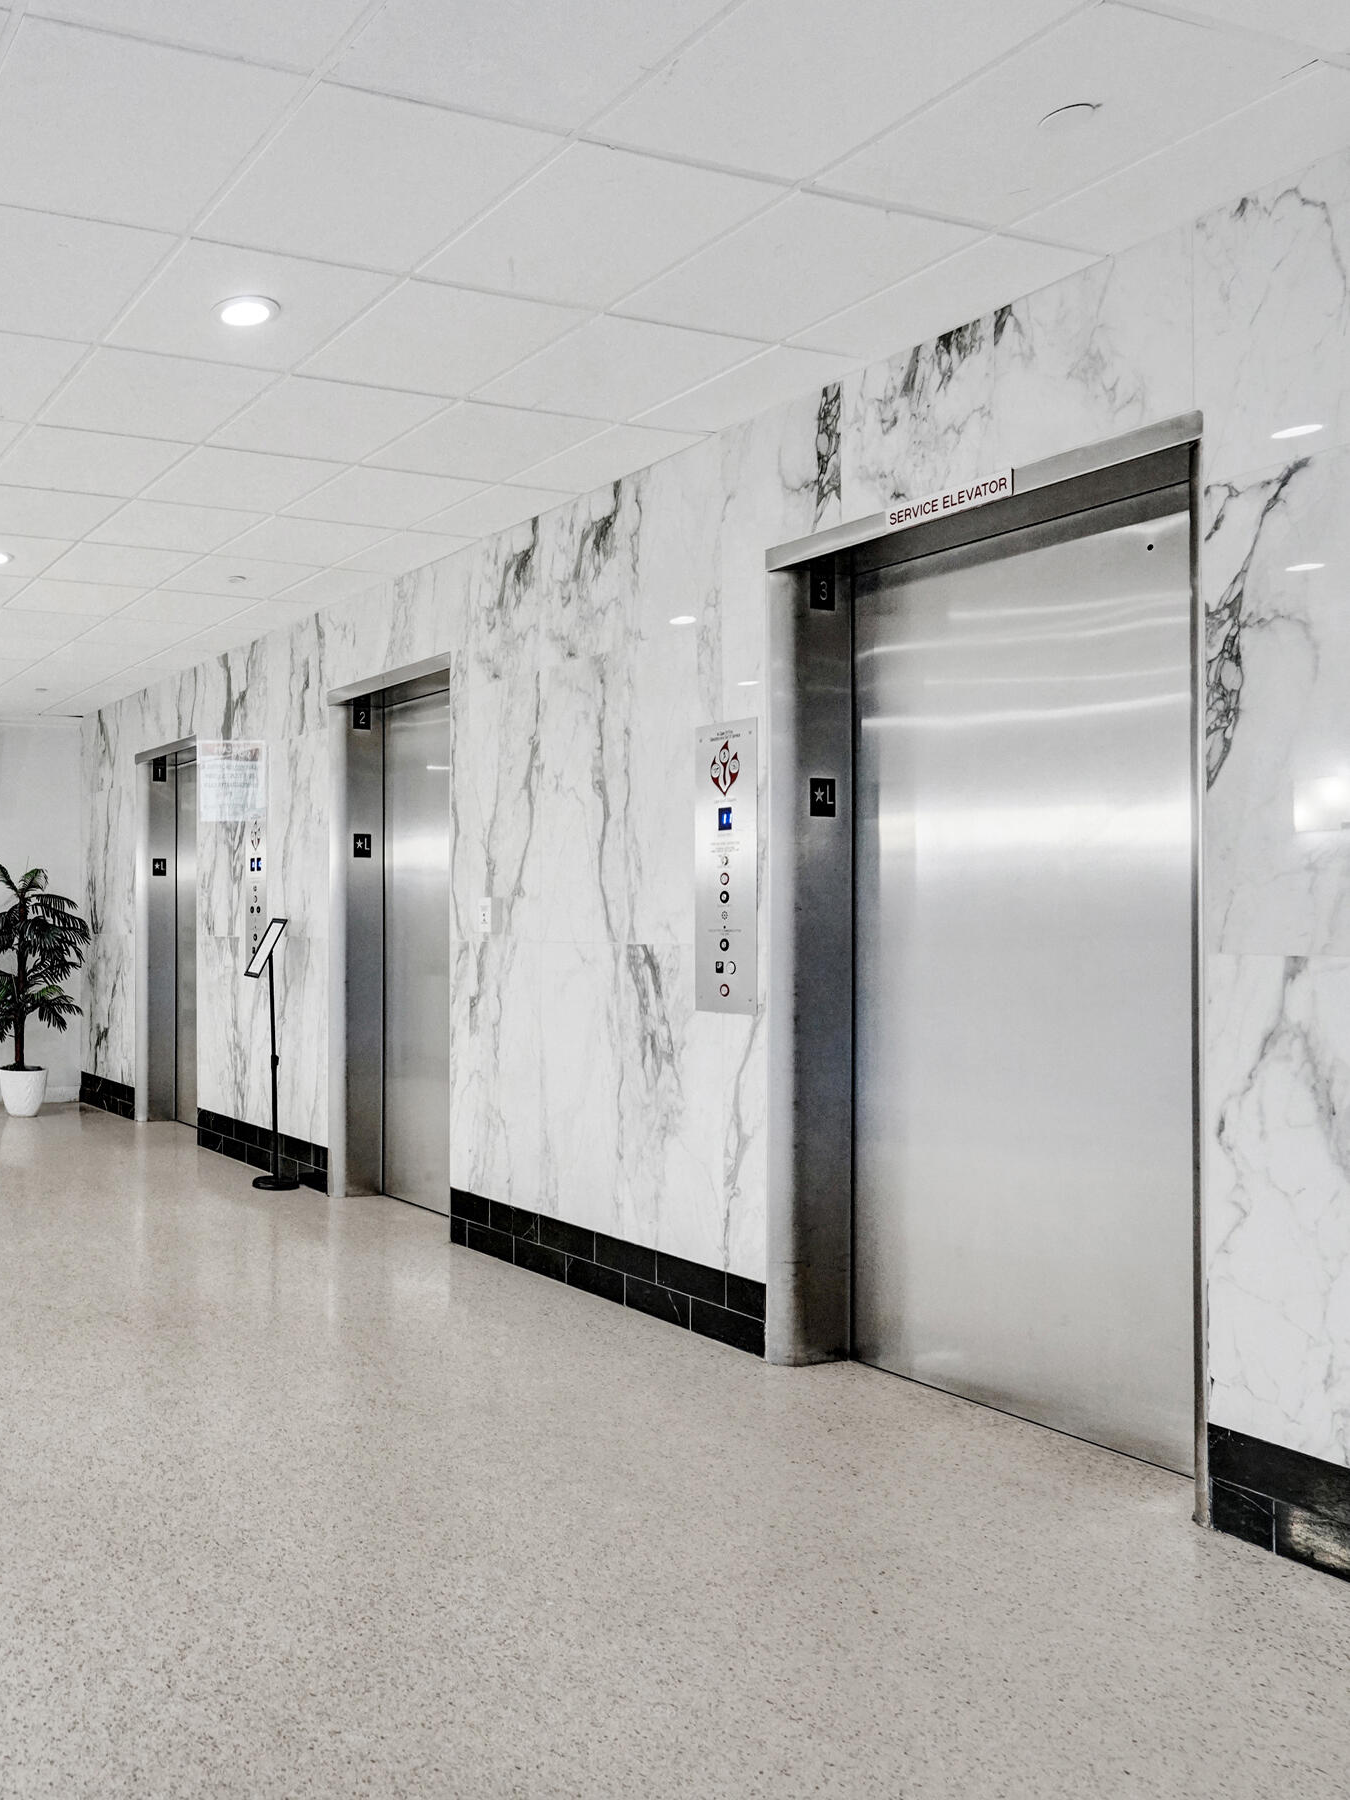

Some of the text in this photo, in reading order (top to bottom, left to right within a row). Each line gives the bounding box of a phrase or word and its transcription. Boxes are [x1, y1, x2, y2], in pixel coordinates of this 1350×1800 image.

[890, 477, 1008, 525] SERVICE ELEVATOR
[819, 580, 828, 601] 3
[359, 711, 366, 725] 2
